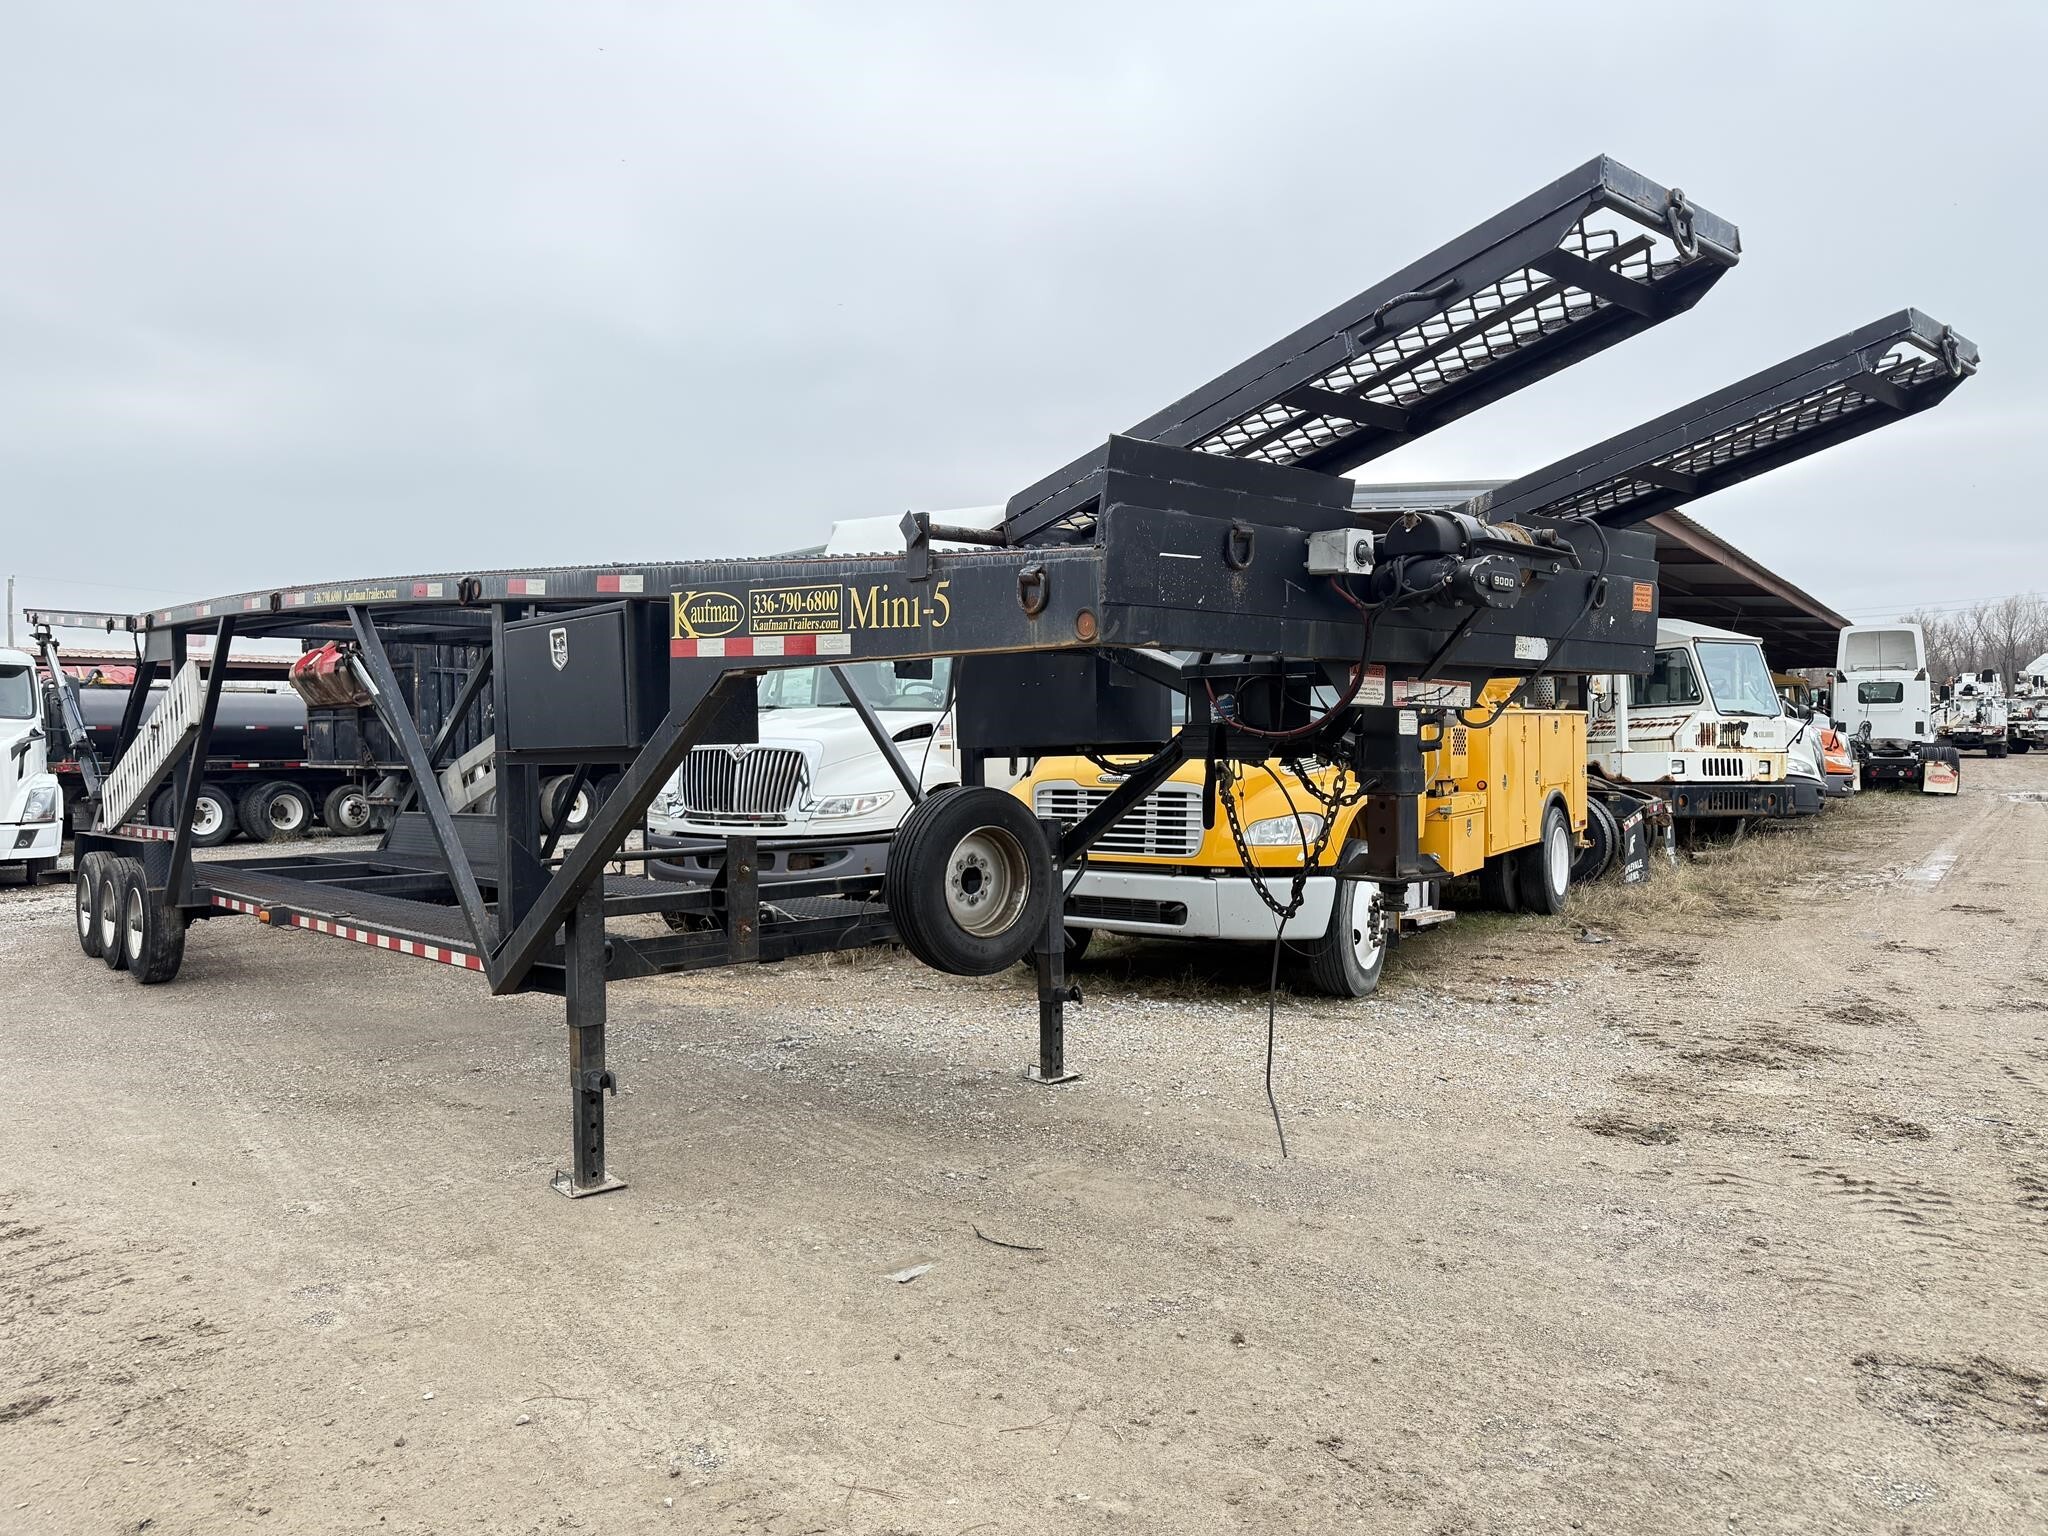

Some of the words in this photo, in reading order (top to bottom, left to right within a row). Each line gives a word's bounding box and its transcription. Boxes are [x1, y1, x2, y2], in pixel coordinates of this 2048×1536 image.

[1494, 575, 1515, 588] 9000
[752, 589, 839, 614] 336-790-6800
[847, 580, 950, 630] Mini-5
[671, 591, 738, 639] Kaufman
[752, 617, 839, 632] KaufmanTrailers.com
